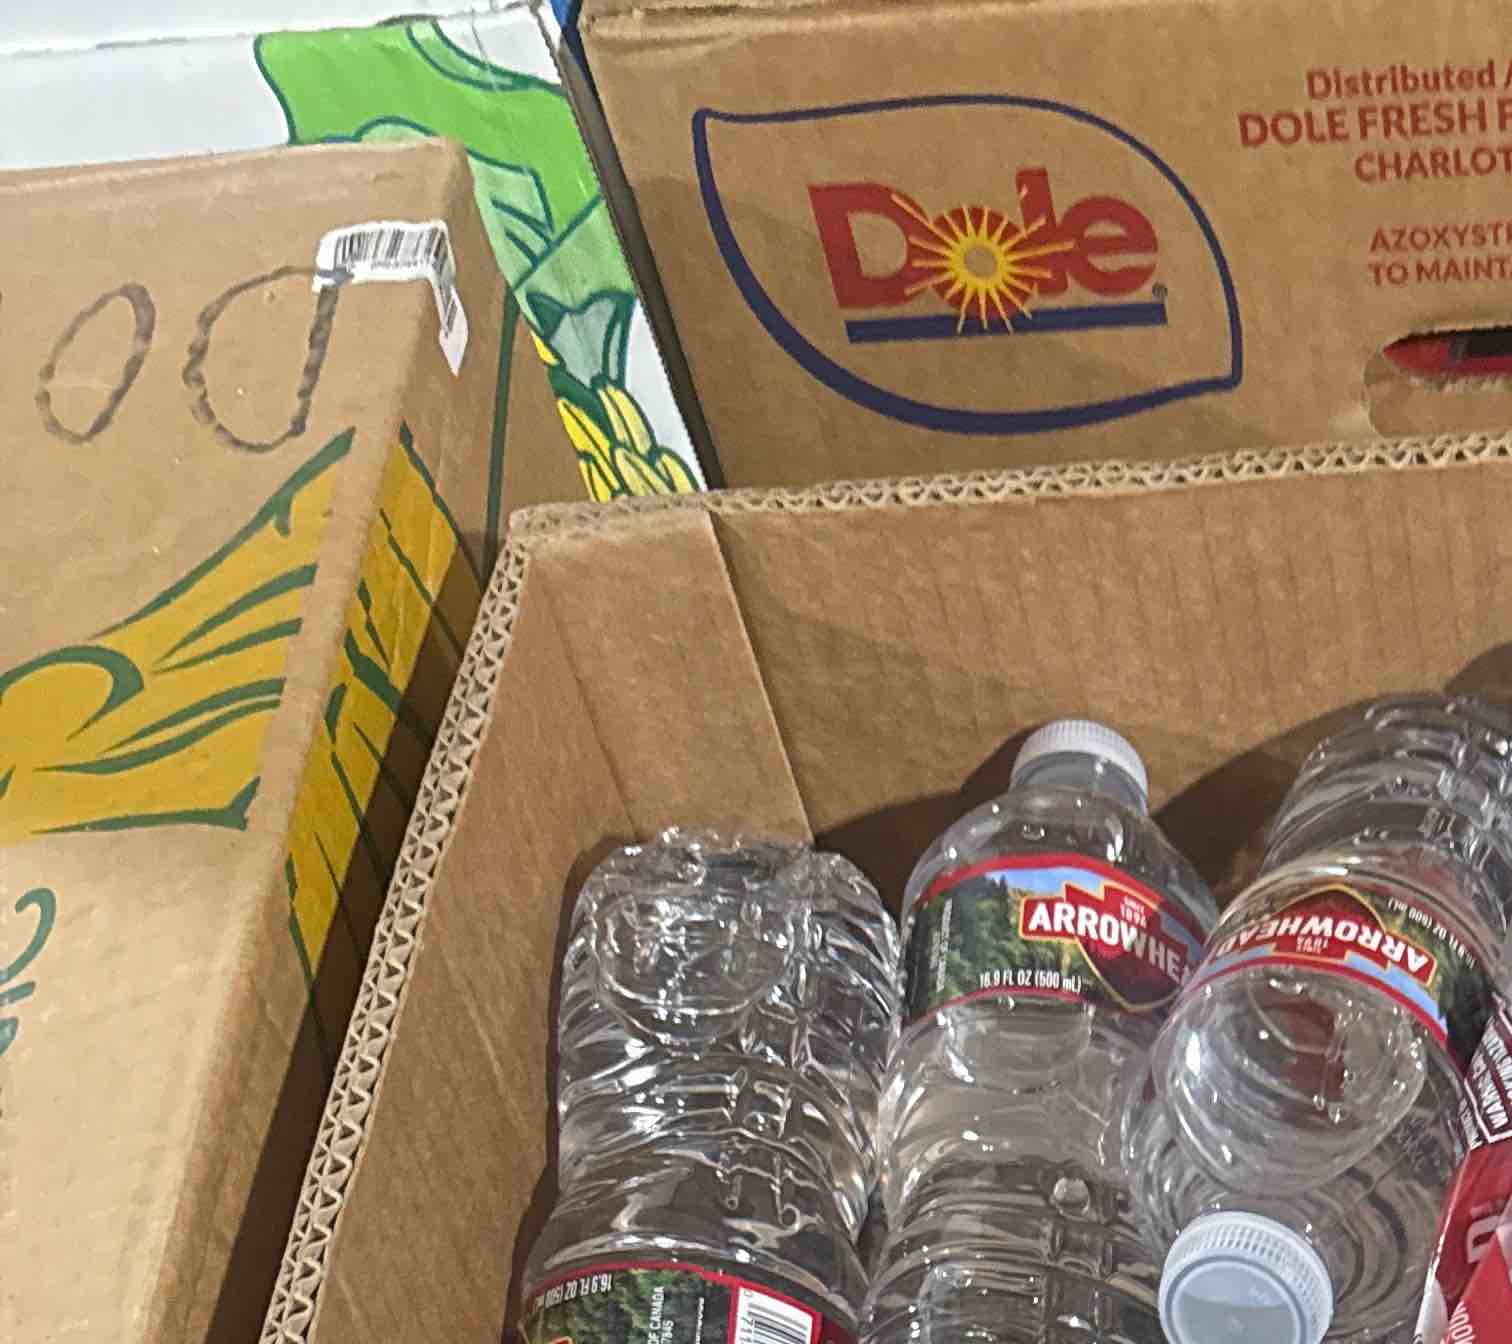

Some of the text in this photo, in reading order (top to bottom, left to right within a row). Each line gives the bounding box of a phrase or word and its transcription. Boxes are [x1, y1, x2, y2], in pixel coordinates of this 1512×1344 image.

[1306, 61, 1496, 99] Distributed
[1238, 110, 1349, 148] DOLE
[1358, 100, 1489, 140] FRESH
[808, 167, 1160, 320] Dole
[1368, 262, 1409, 288] TO
[652, 1286, 665, 1330] CANADA
